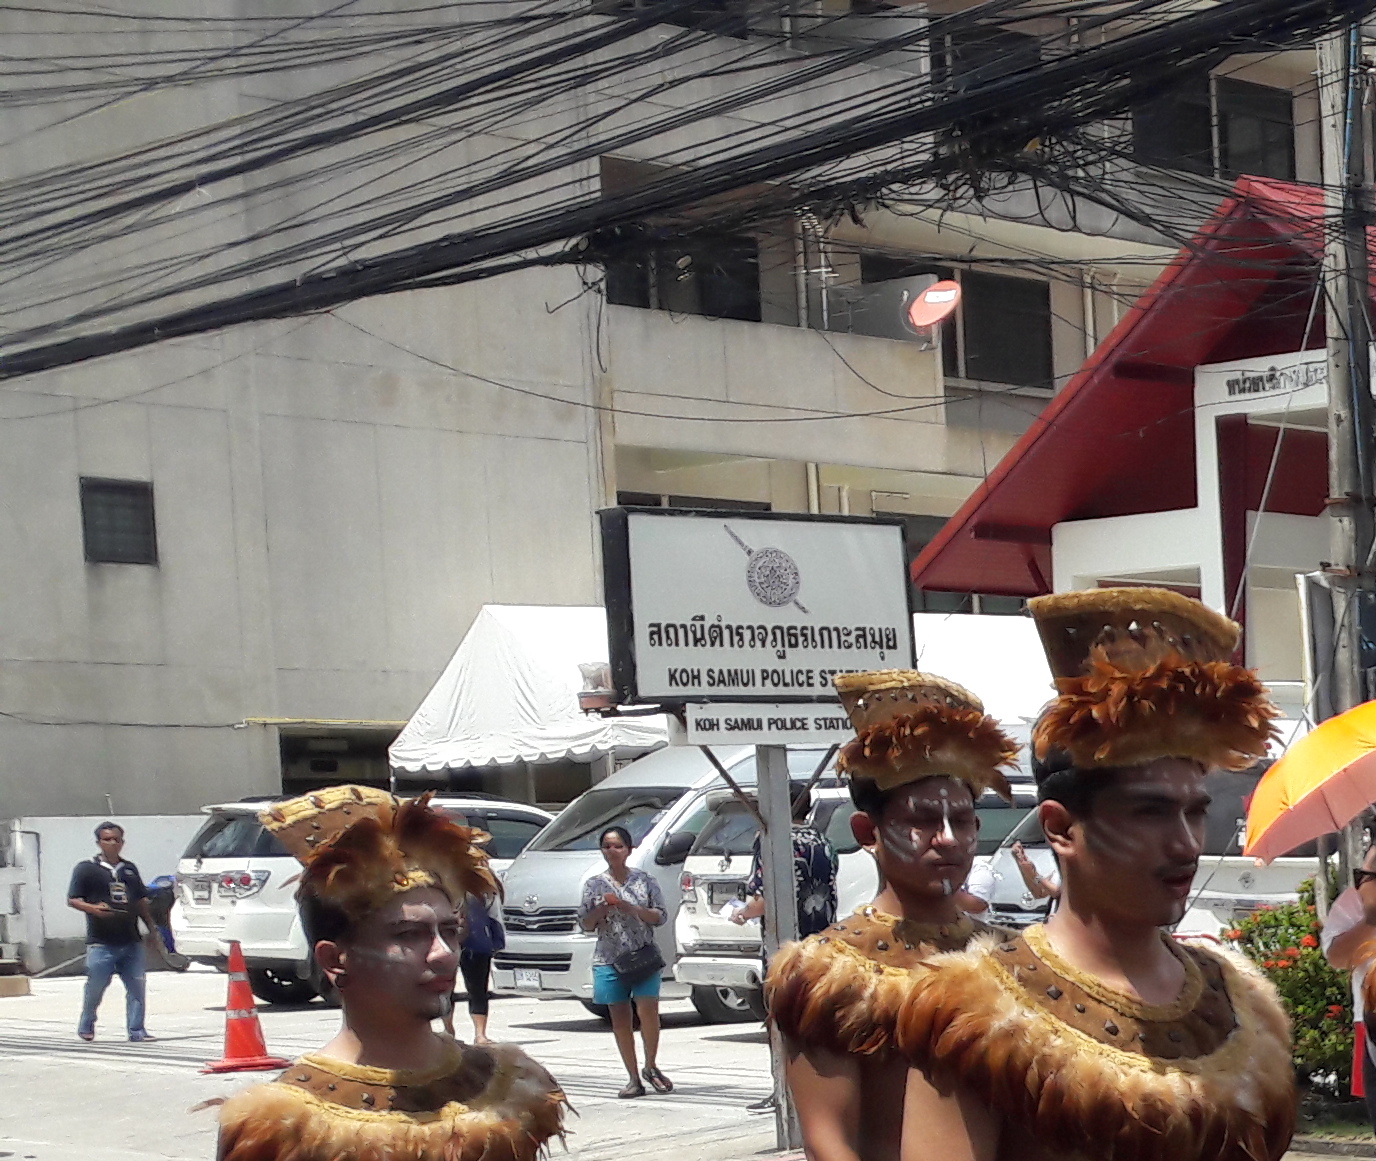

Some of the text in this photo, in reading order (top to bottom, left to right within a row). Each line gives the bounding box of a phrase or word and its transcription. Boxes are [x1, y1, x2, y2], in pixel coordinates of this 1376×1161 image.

[648, 615, 897, 661] สถานีตำรวจภูธรเกาะสมุย
[668, 667, 702, 688] KOH
[706, 667, 756, 688] SAMUI
[761, 668, 815, 688] POLICE
[695, 717, 853, 731] KOH SAMUI POLICE STATIO
